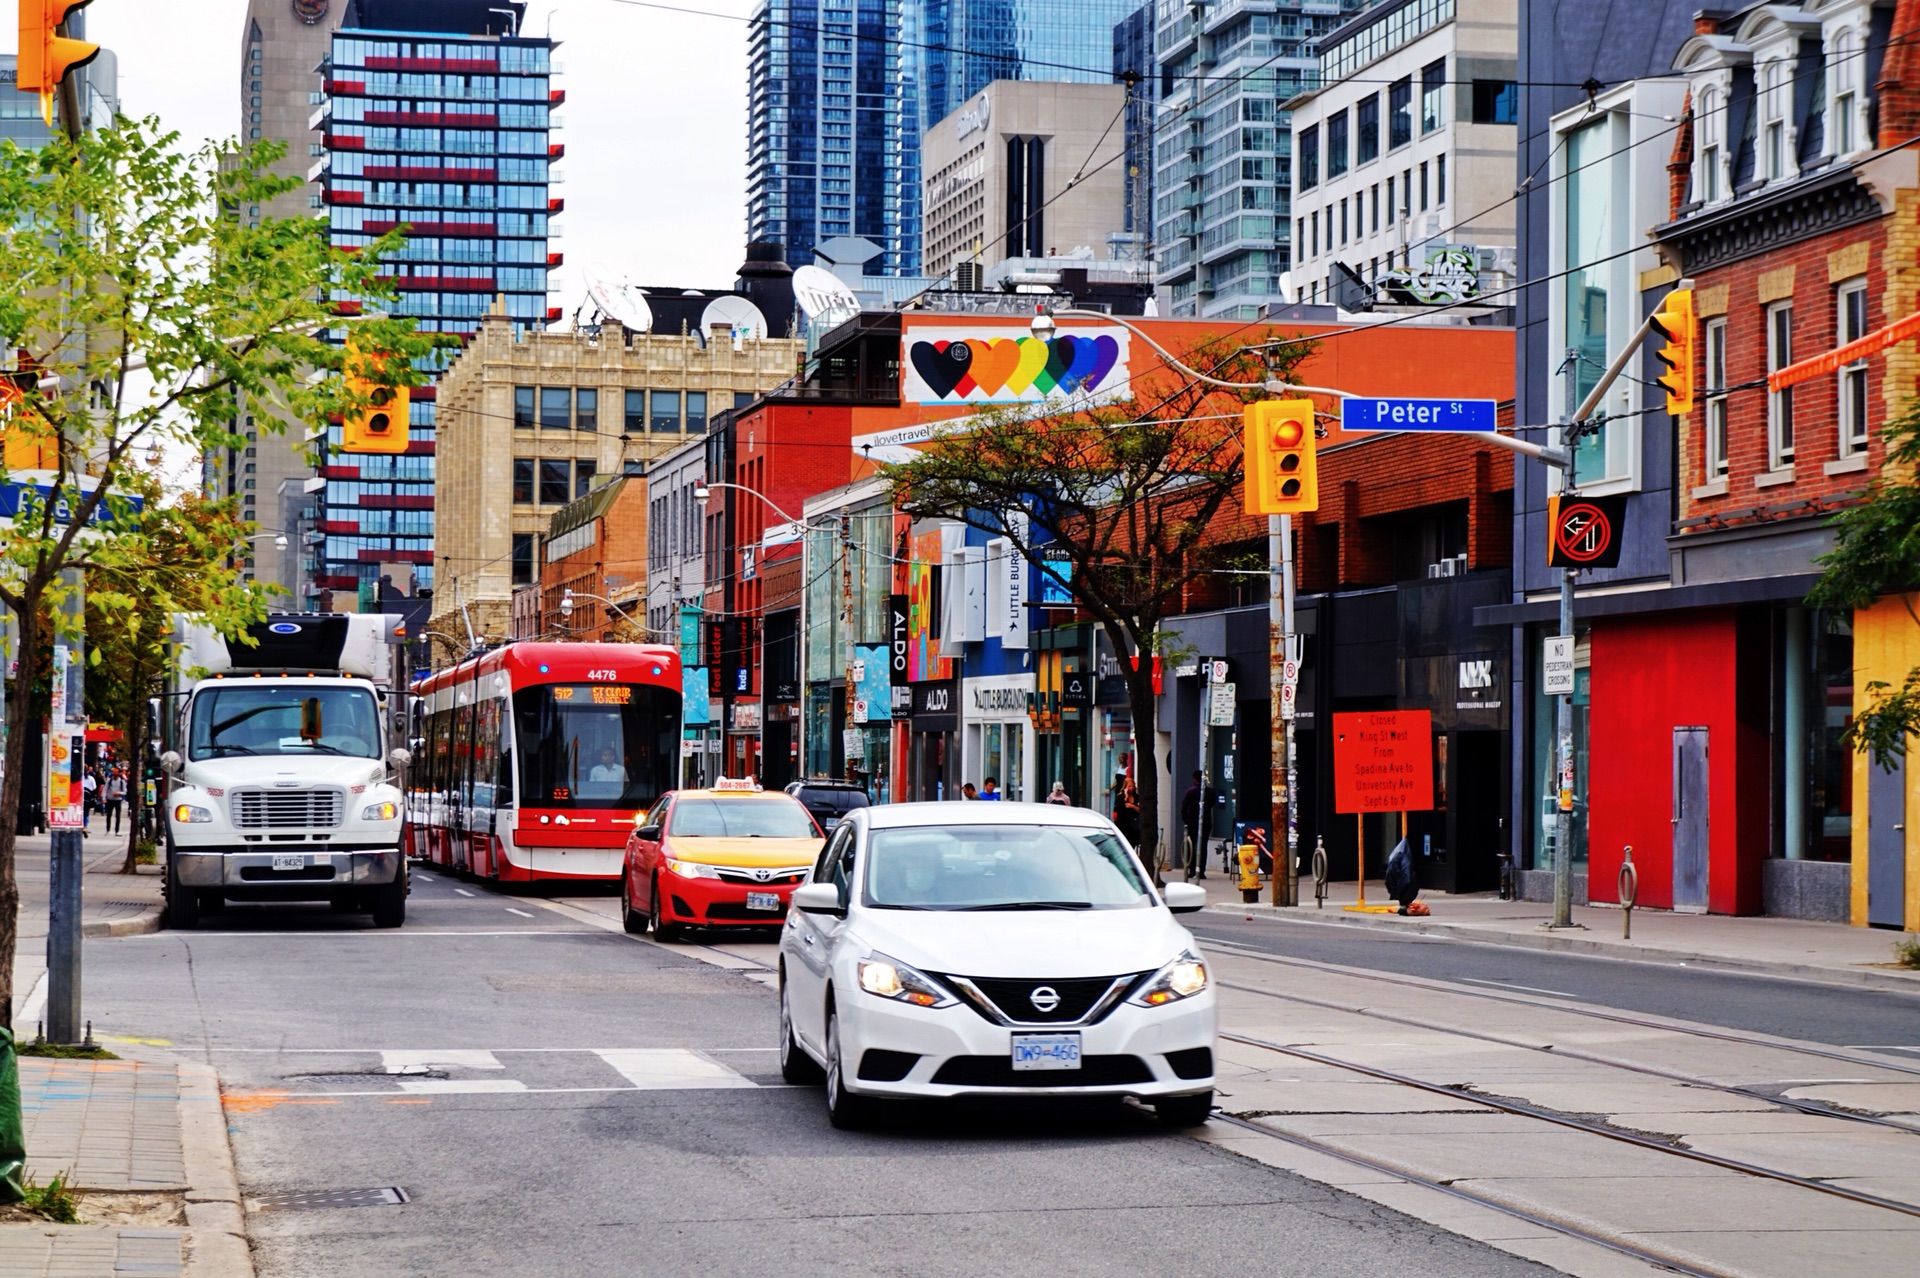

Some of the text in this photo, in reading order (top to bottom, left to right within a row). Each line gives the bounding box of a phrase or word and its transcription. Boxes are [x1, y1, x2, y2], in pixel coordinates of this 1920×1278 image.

[1376, 401, 1463, 423] Peter St
[1010, 584, 1019, 619] LITTLE
[712, 625, 721, 664] Locker
[894, 610, 906, 671] ALDO
[1555, 644, 1564, 656] NO
[1546, 661, 1573, 672] PEDESTRIAN
[587, 670, 616, 680] 4476
[738, 669, 747, 690] kids
[1460, 660, 1492, 688] NYX
[1548, 675, 1570, 686] CROSSING
[554, 688, 573, 699] 512
[592, 687, 604, 697] ST
[926, 689, 948, 711] ALDO
[1370, 715, 1396, 725] Closed
[1360, 731, 1408, 744] King St West
[1374, 747, 1394, 757] From
[1355, 764, 1413, 776] Spadina Ave to
[1356, 779, 1413, 791] University Ave
[1364, 796, 1381, 808] Sept
[1390, 796, 1398, 804] to
[1400, 795, 1406, 806] 9
